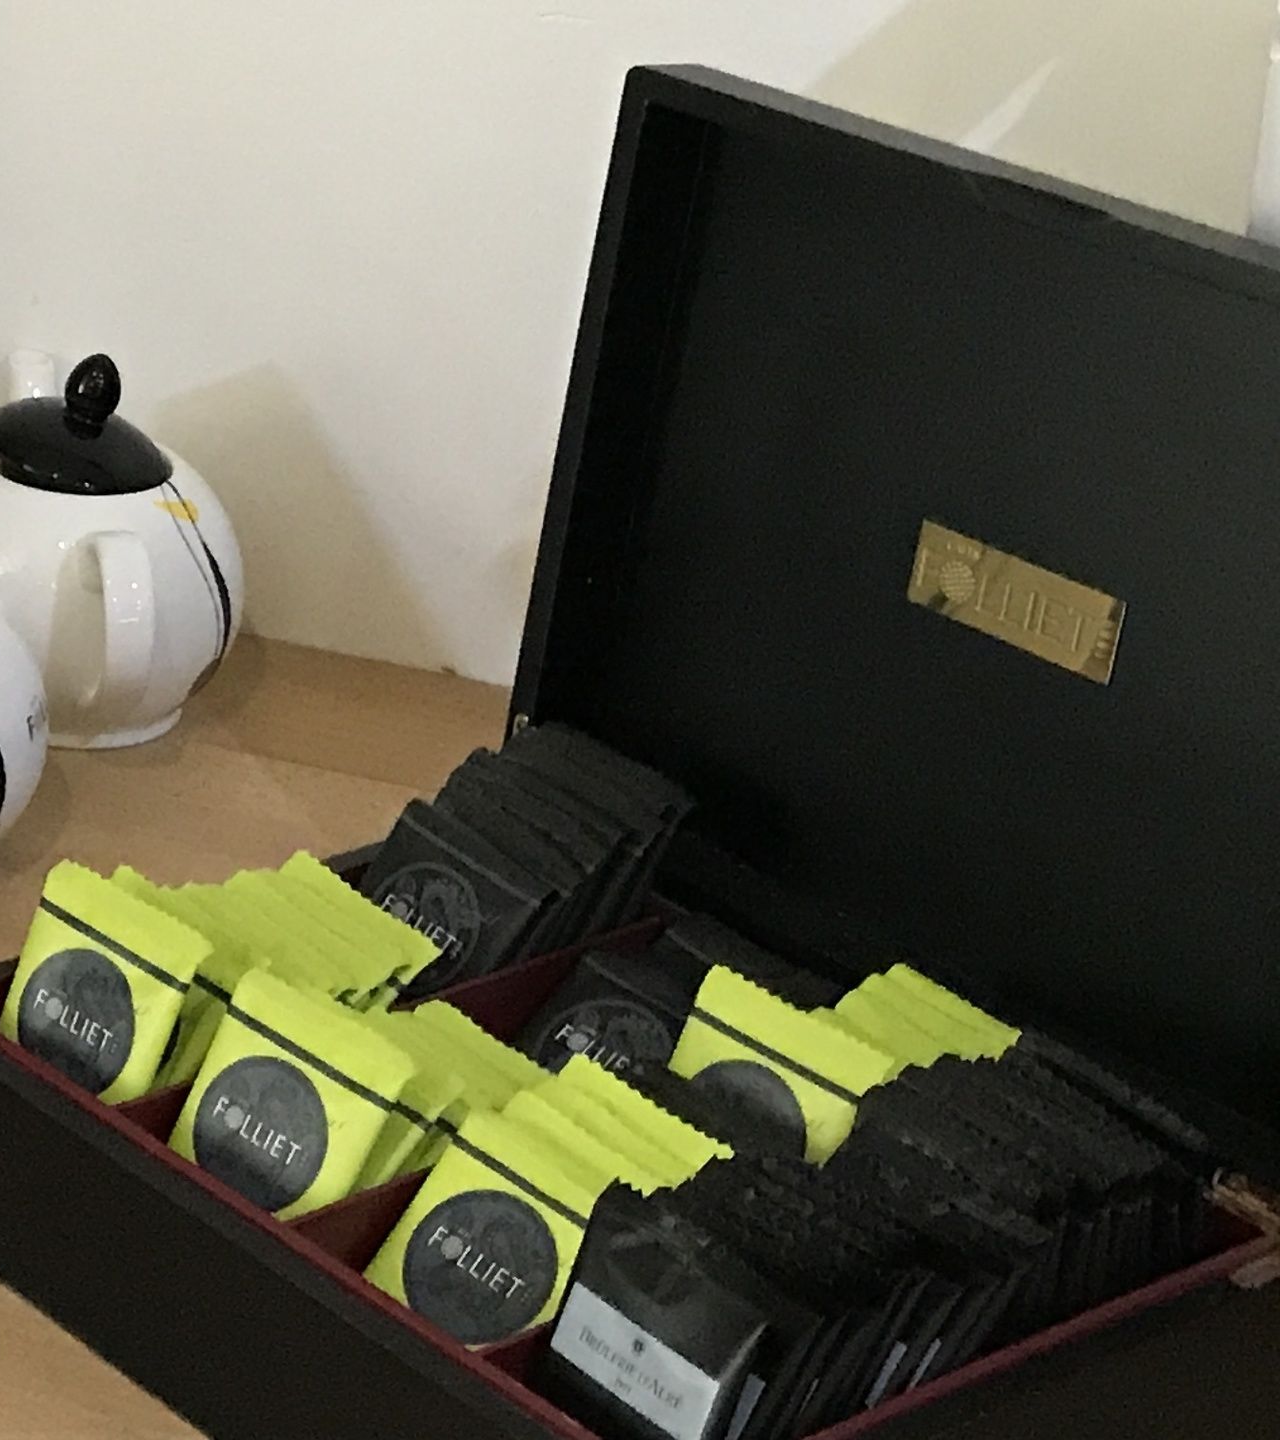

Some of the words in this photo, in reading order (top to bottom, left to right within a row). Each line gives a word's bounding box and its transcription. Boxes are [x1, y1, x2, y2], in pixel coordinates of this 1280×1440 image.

[33, 988, 114, 1052] FOLLIET
[212, 1095, 303, 1165] FOLLIET
[427, 1225, 526, 1299] FOLLIET
